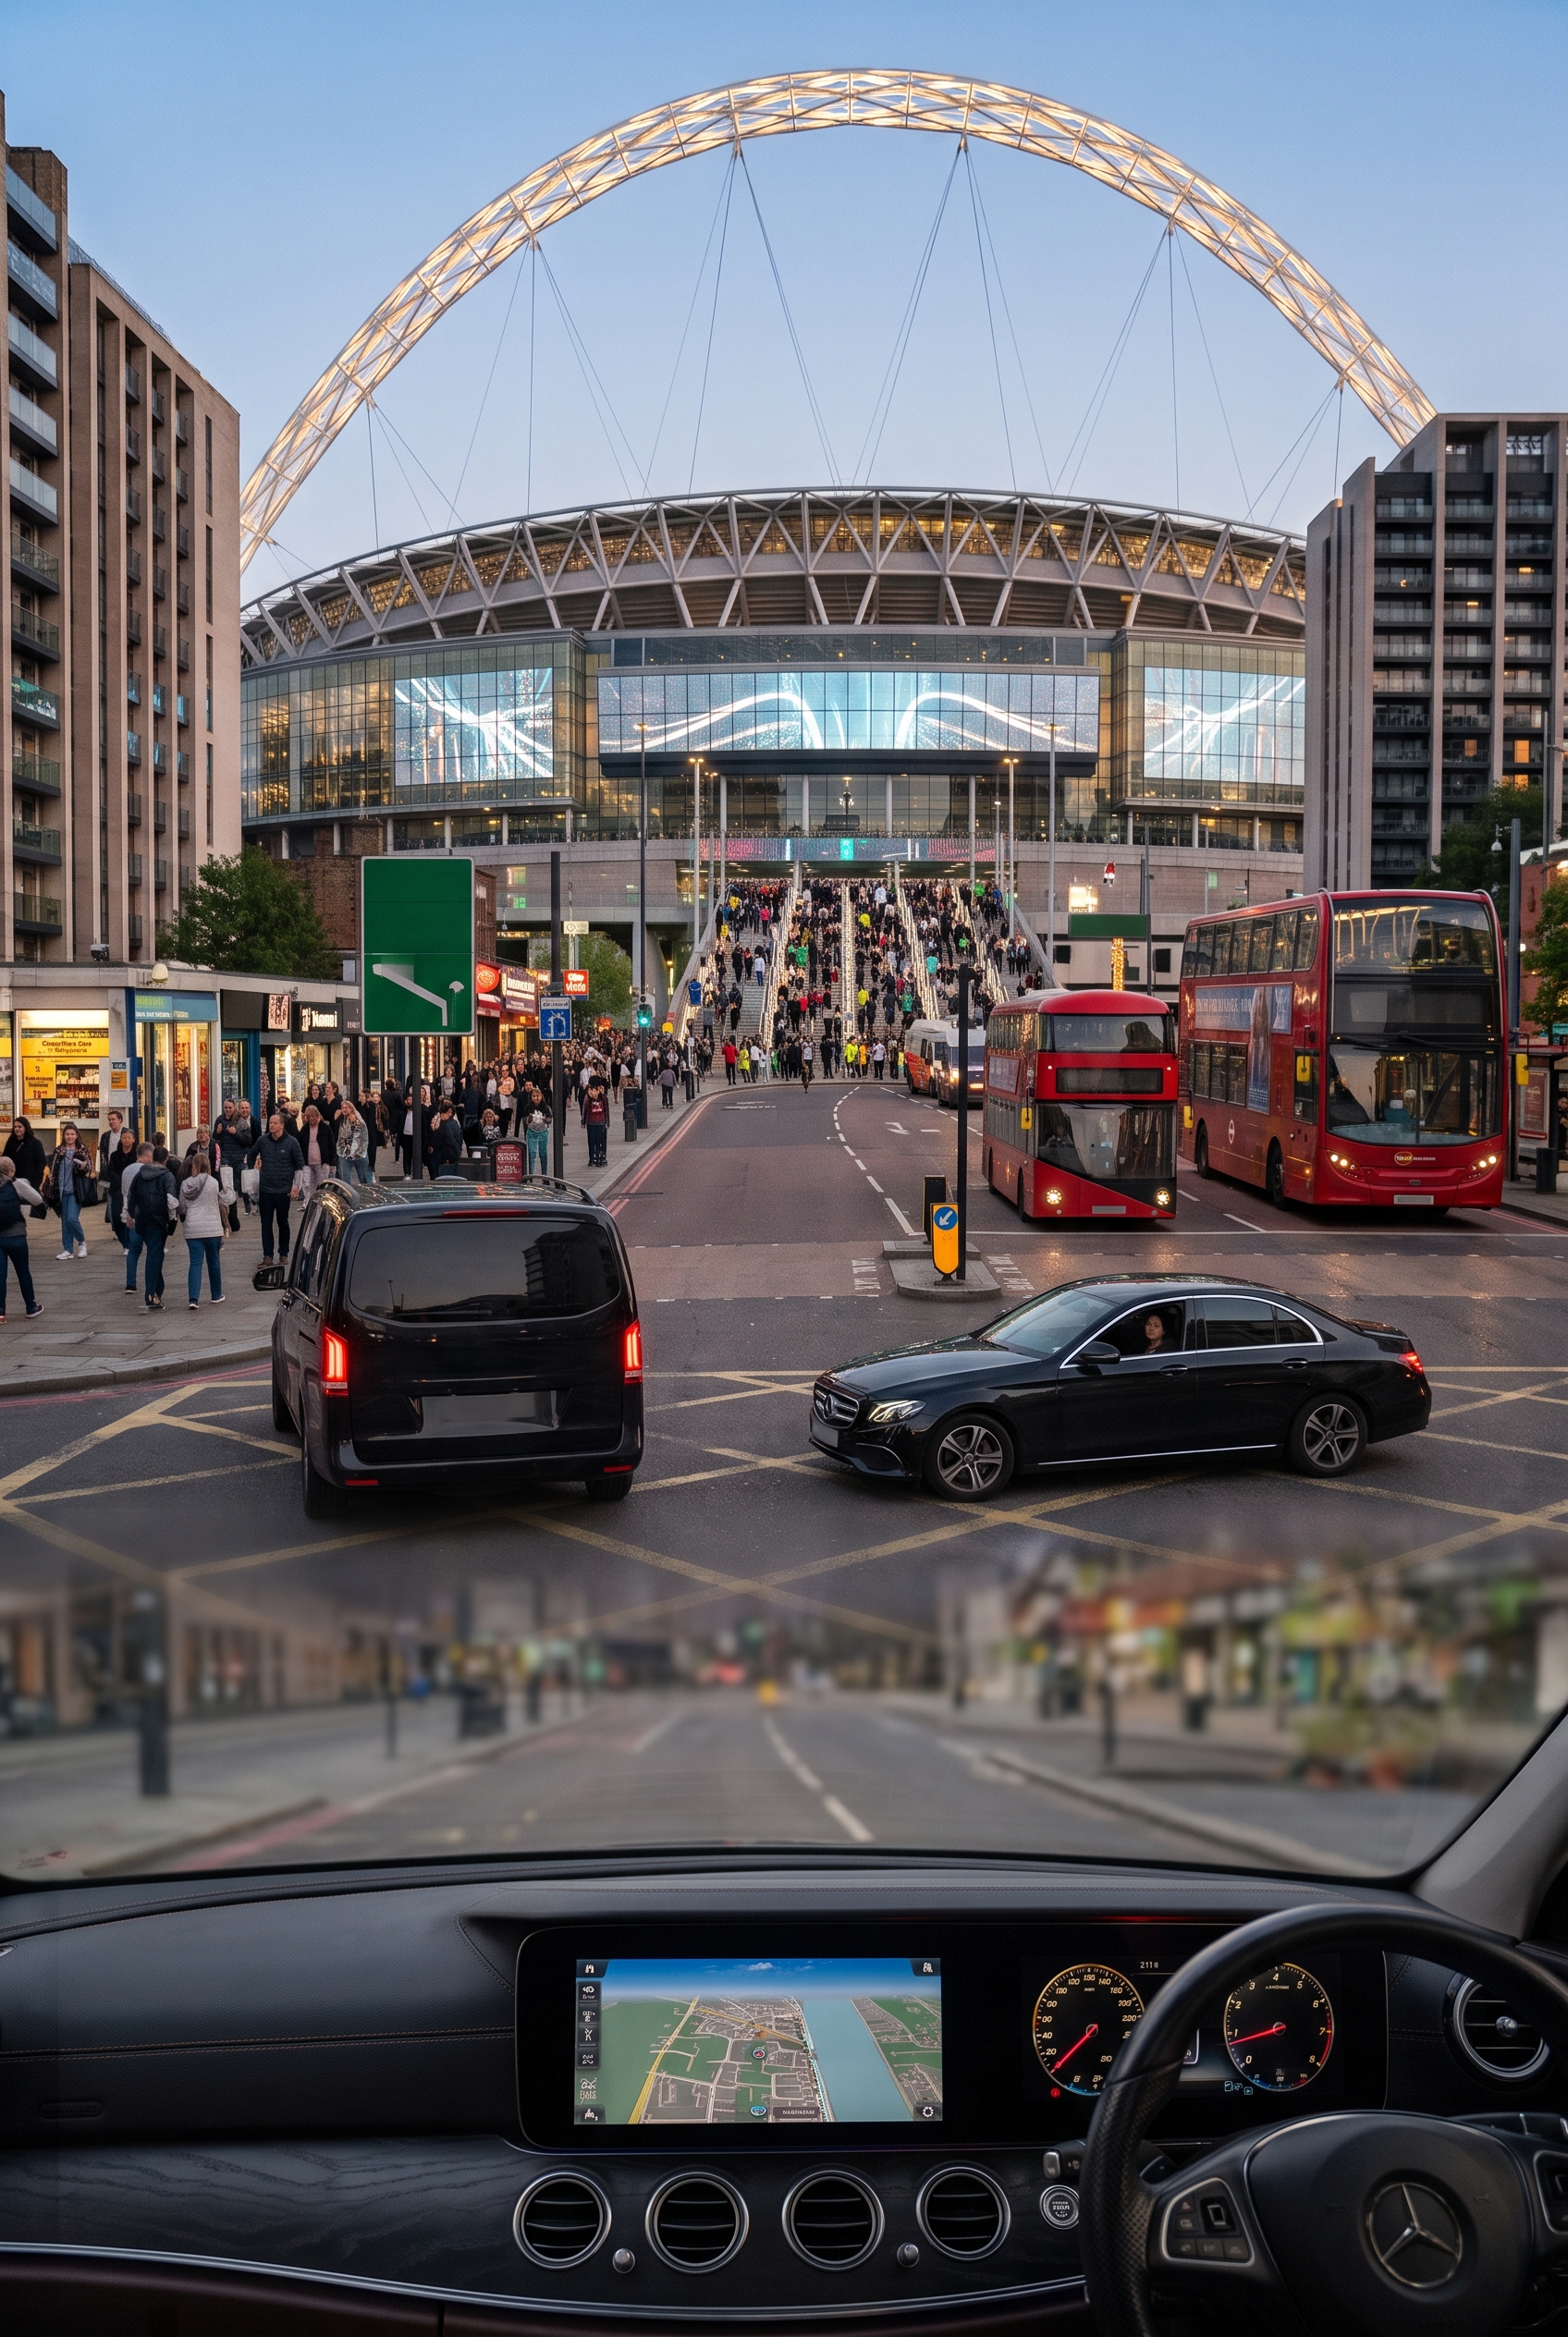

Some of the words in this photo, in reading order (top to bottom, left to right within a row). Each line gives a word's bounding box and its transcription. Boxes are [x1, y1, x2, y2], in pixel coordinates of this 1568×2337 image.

[1272, 1973, 1280, 1982] 4
[1249, 1981, 1256, 1990] 3
[1296, 1980, 1304, 1989] 5
[1234, 2001, 1242, 2009] 2
[1312, 2000, 1319, 2008] 6
[1042, 2031, 1053, 2039] 40
[1233, 2028, 1239, 2037] 1
[1318, 2027, 1326, 2036] 7
[1046, 2048, 1057, 2056] 20
[1245, 2055, 1253, 2064] 0
[1308, 2054, 1316, 2063] 8
